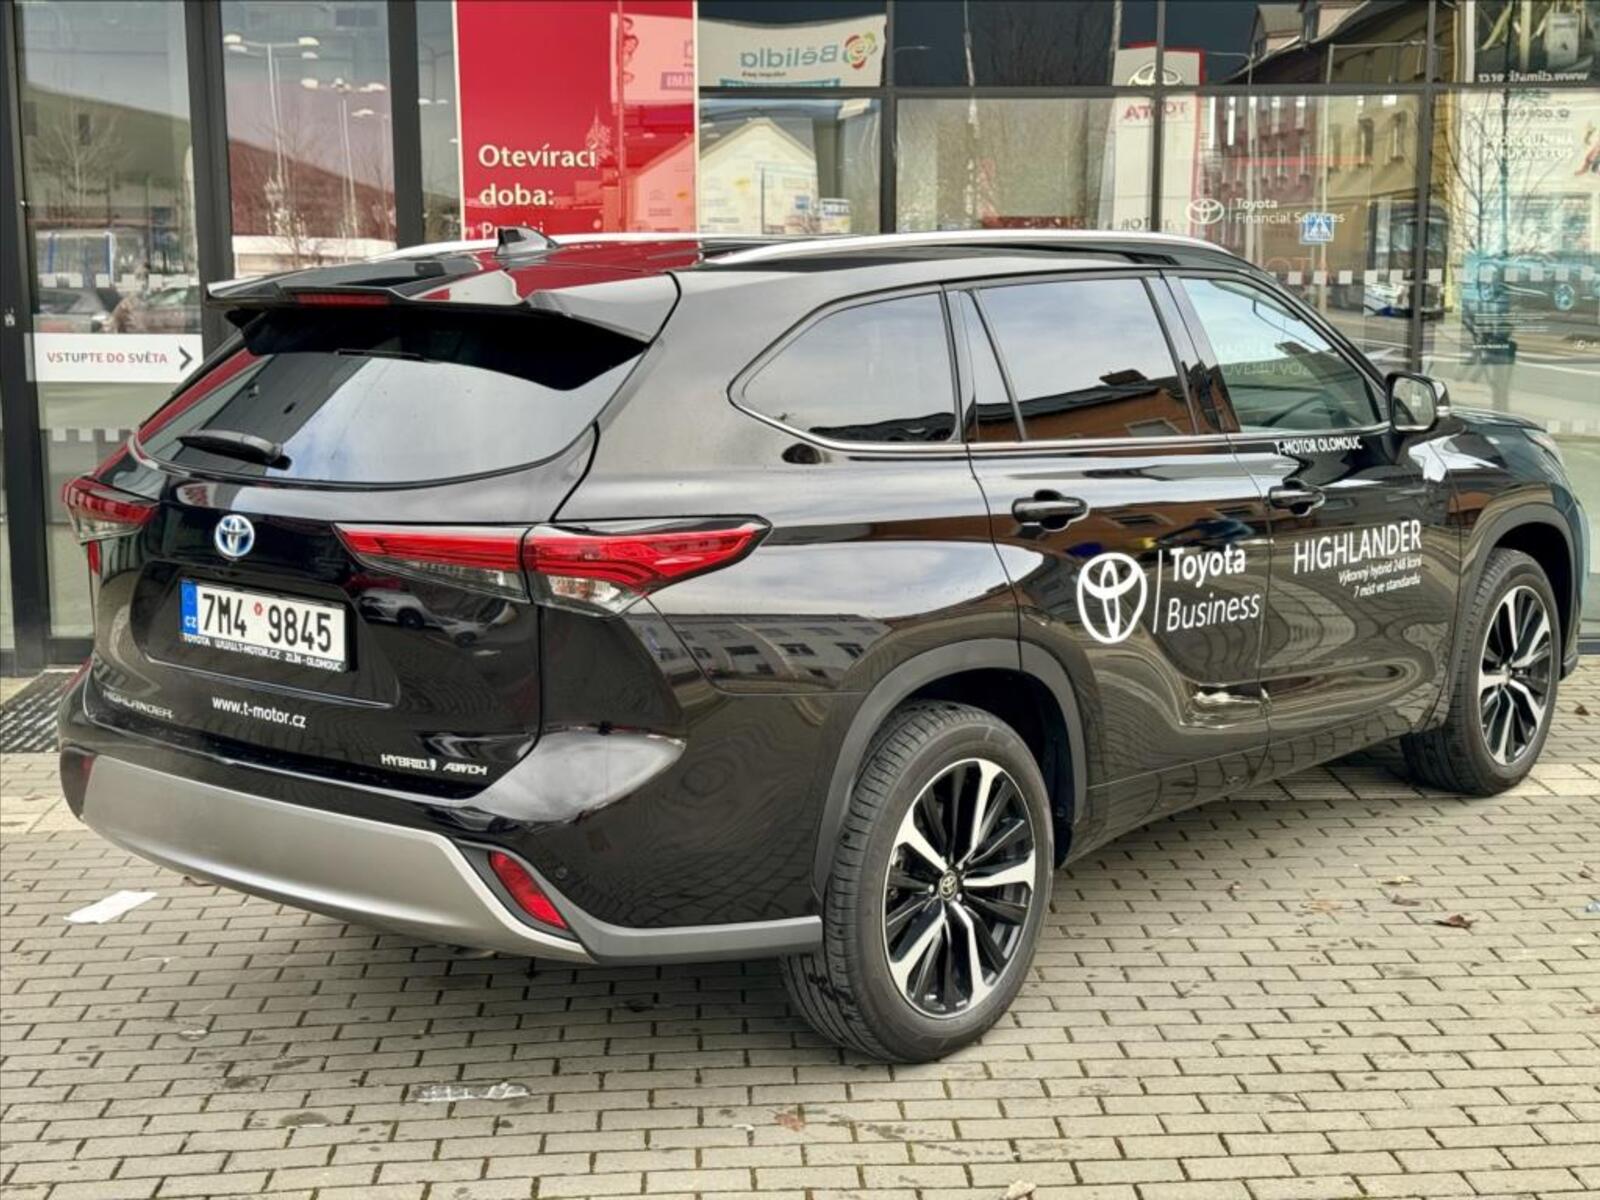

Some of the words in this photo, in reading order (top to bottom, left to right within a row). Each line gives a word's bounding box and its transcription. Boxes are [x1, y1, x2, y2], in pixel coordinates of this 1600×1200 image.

[478, 144, 597, 168] Otevírací
[479, 183, 554, 206] doba:
[1235, 198, 1278, 212] Toyota
[1235, 212, 1291, 224] Financial
[47, 352, 104, 364] VSTUPTE
[106, 353, 125, 363] DO
[1274, 438, 1318, 455] T-MOTOR
[1318, 435, 1362, 452] OLOMOUC
[1293, 519, 1422, 575] HIGHLANDER
[1170, 544, 1246, 588] Toyota
[1353, 585, 1360, 599] 7
[185, 616, 197, 628] CZ
[202, 593, 247, 637] 7M4
[268, 605, 331, 653] 9845
[1166, 592, 1262, 631] Business
[183, 633, 211, 646] TOYOTA
[103, 690, 175, 719] HIGHLANDER
[212, 697, 306, 728] www.t-motor.cz
